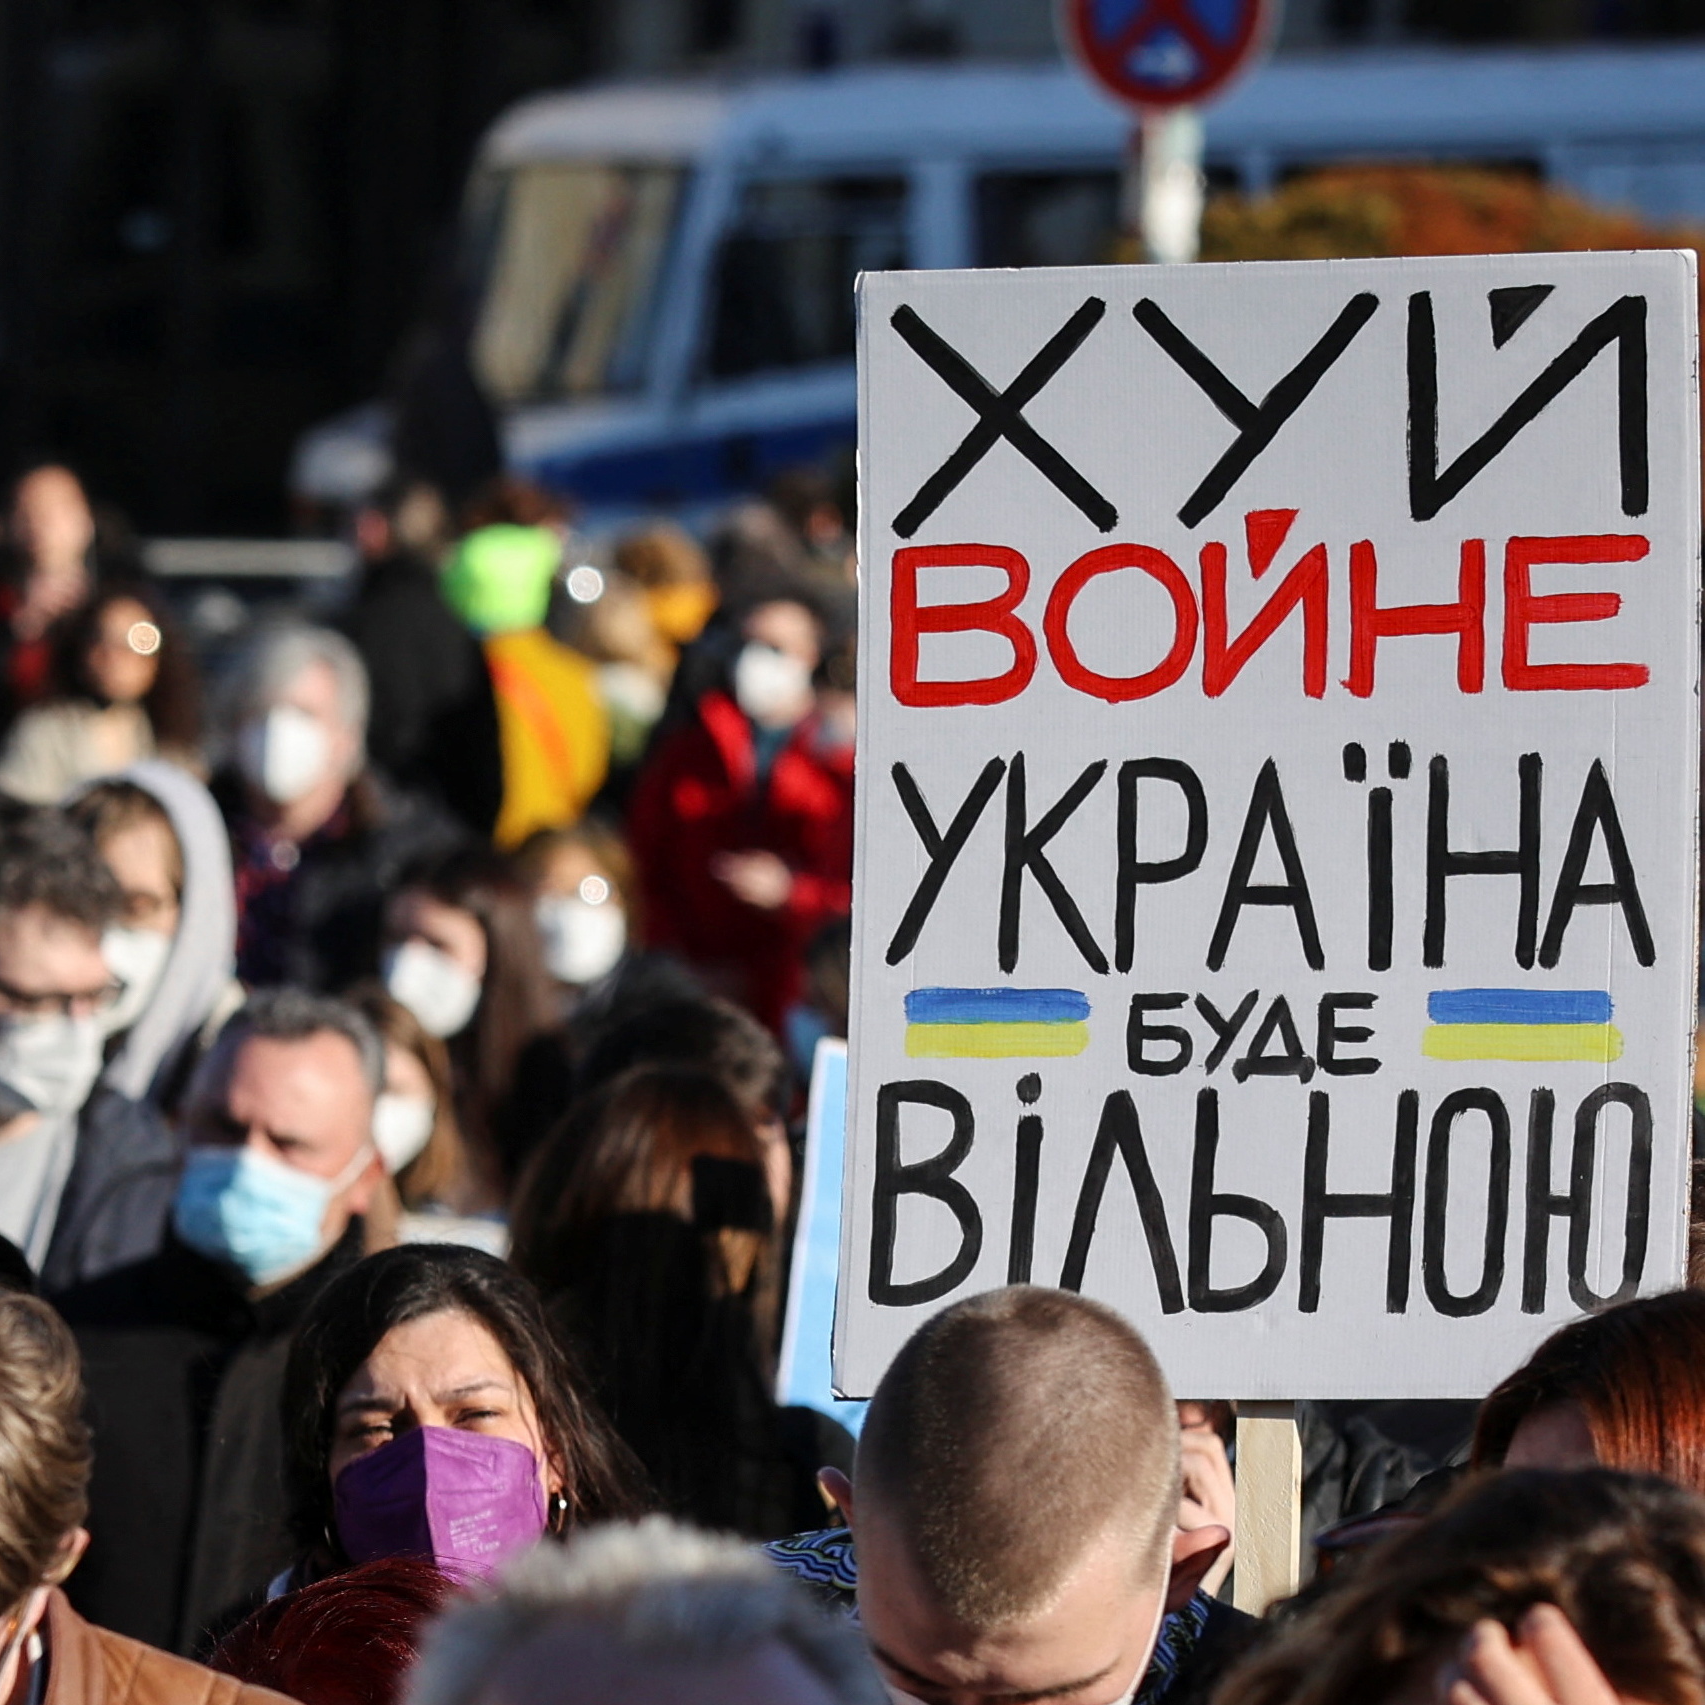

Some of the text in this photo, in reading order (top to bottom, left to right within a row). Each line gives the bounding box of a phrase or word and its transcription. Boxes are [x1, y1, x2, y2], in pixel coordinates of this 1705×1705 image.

[890, 284, 1650, 538] ХУЙ
[890, 508, 1650, 707] ВОЙНЕ
[886, 739, 1657, 975] УКРАЇНА
[1127, 989, 1383, 1083] БУДЕ
